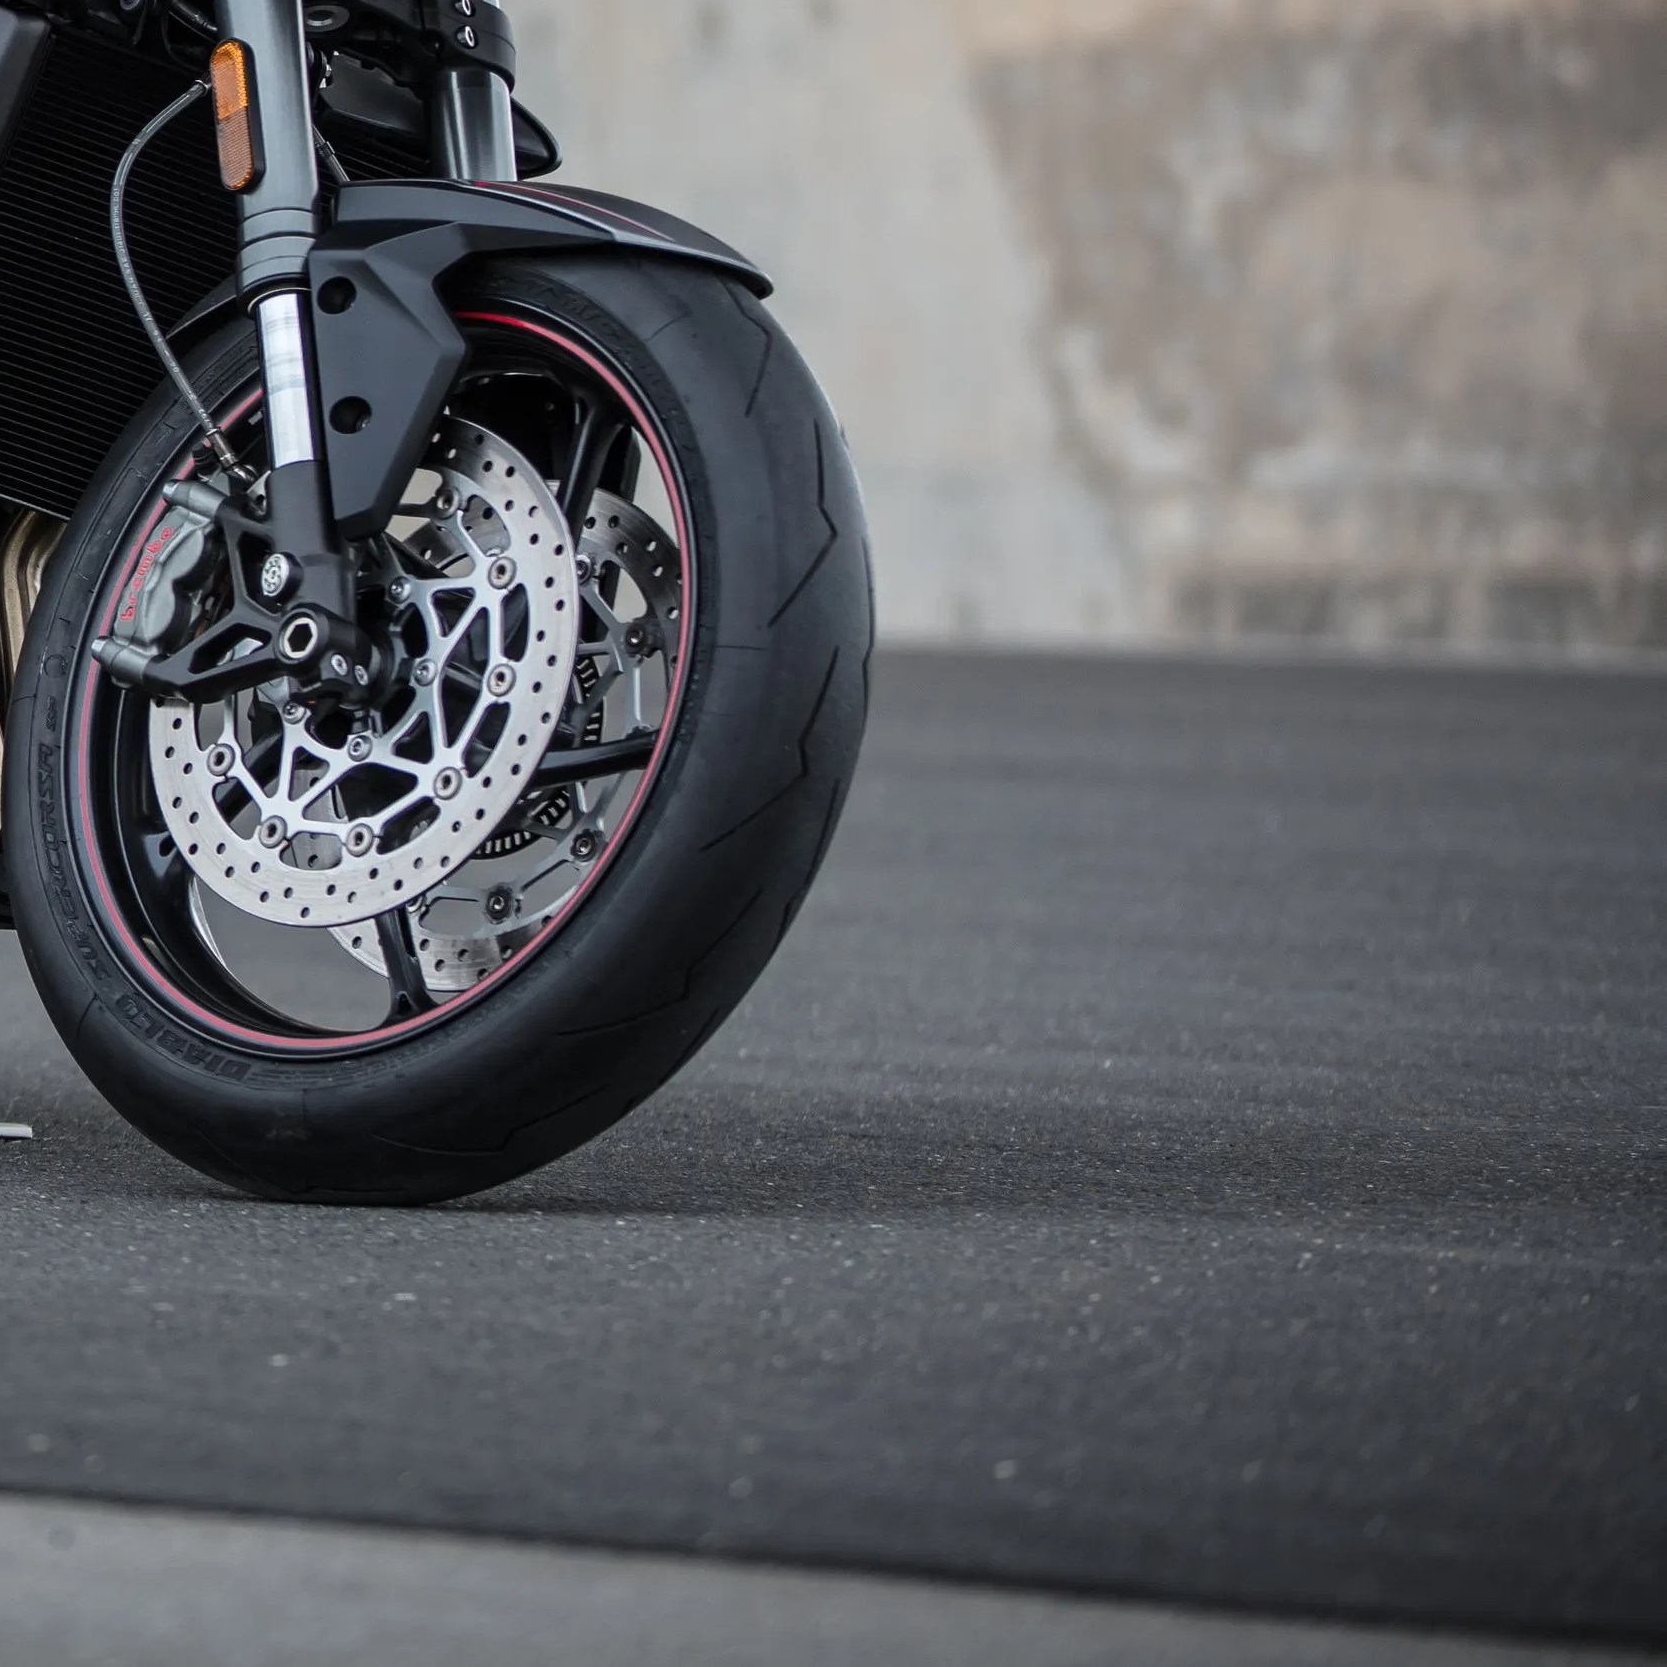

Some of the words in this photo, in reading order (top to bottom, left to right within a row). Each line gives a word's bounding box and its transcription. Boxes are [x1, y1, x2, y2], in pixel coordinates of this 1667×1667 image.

[120, 526, 172, 621] brembo
[38, 742, 113, 982] SUPERCORSA
[114, 992, 253, 1085] DIABLO
